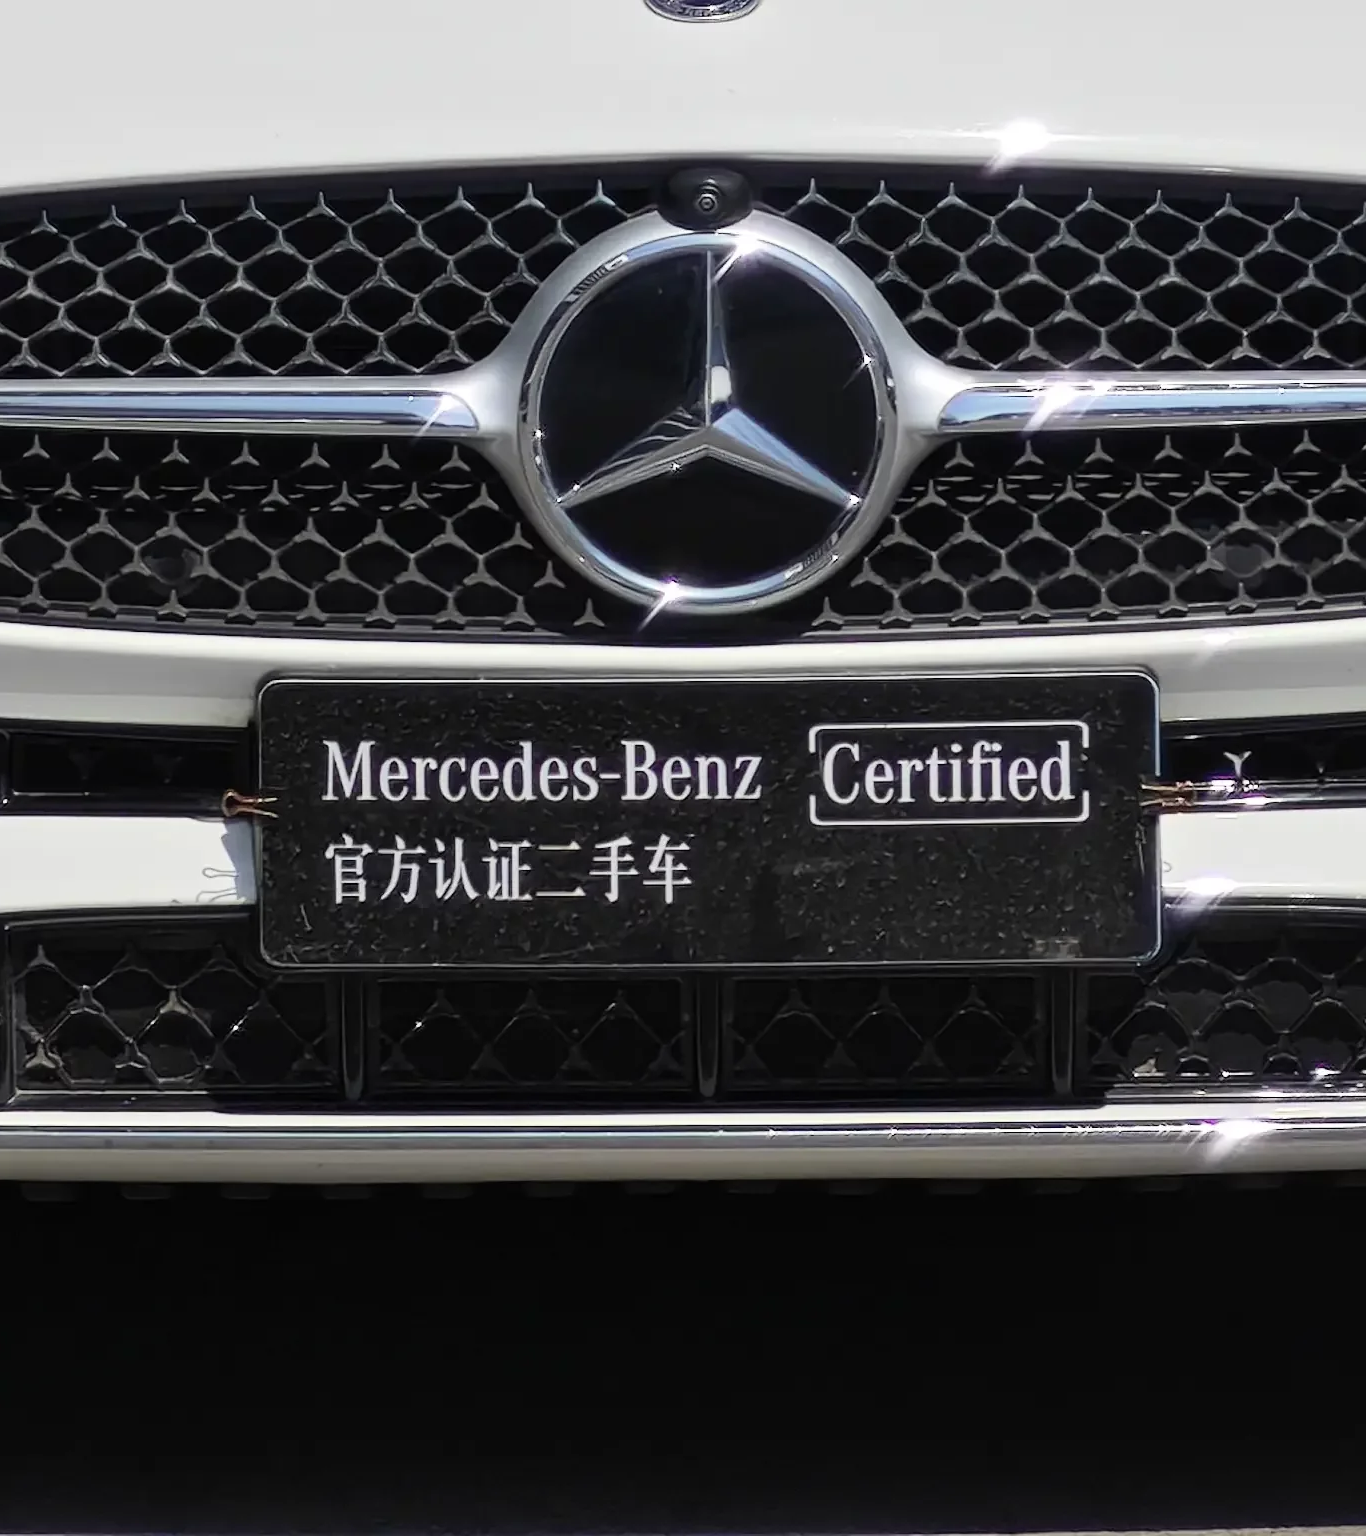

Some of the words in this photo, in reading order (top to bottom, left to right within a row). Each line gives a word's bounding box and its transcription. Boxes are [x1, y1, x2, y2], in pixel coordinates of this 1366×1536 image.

[321, 739, 763, 803] Mercedes-Benz
[821, 739, 1077, 805] Certified
[325, 832, 693, 905] 官方认证二手车
